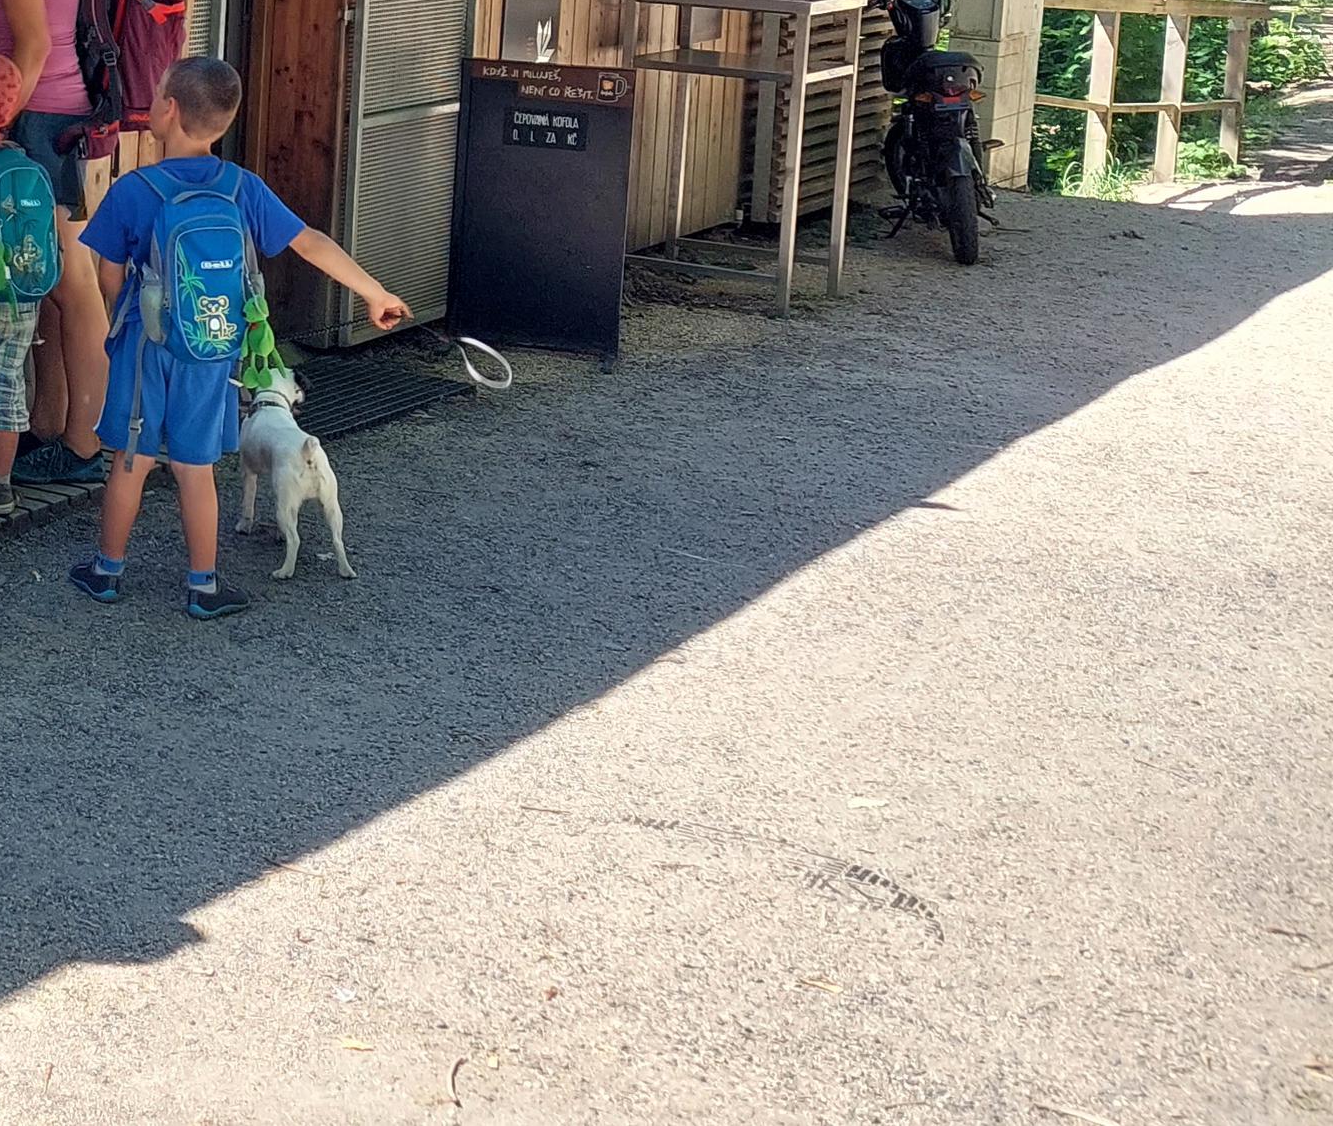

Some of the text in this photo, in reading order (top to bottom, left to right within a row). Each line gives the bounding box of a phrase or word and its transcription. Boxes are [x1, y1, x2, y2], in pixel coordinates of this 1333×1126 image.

[549, 86, 561, 96] CO
[552, 115, 579, 129] KOFOLA
[545, 131, 557, 144] ZA
